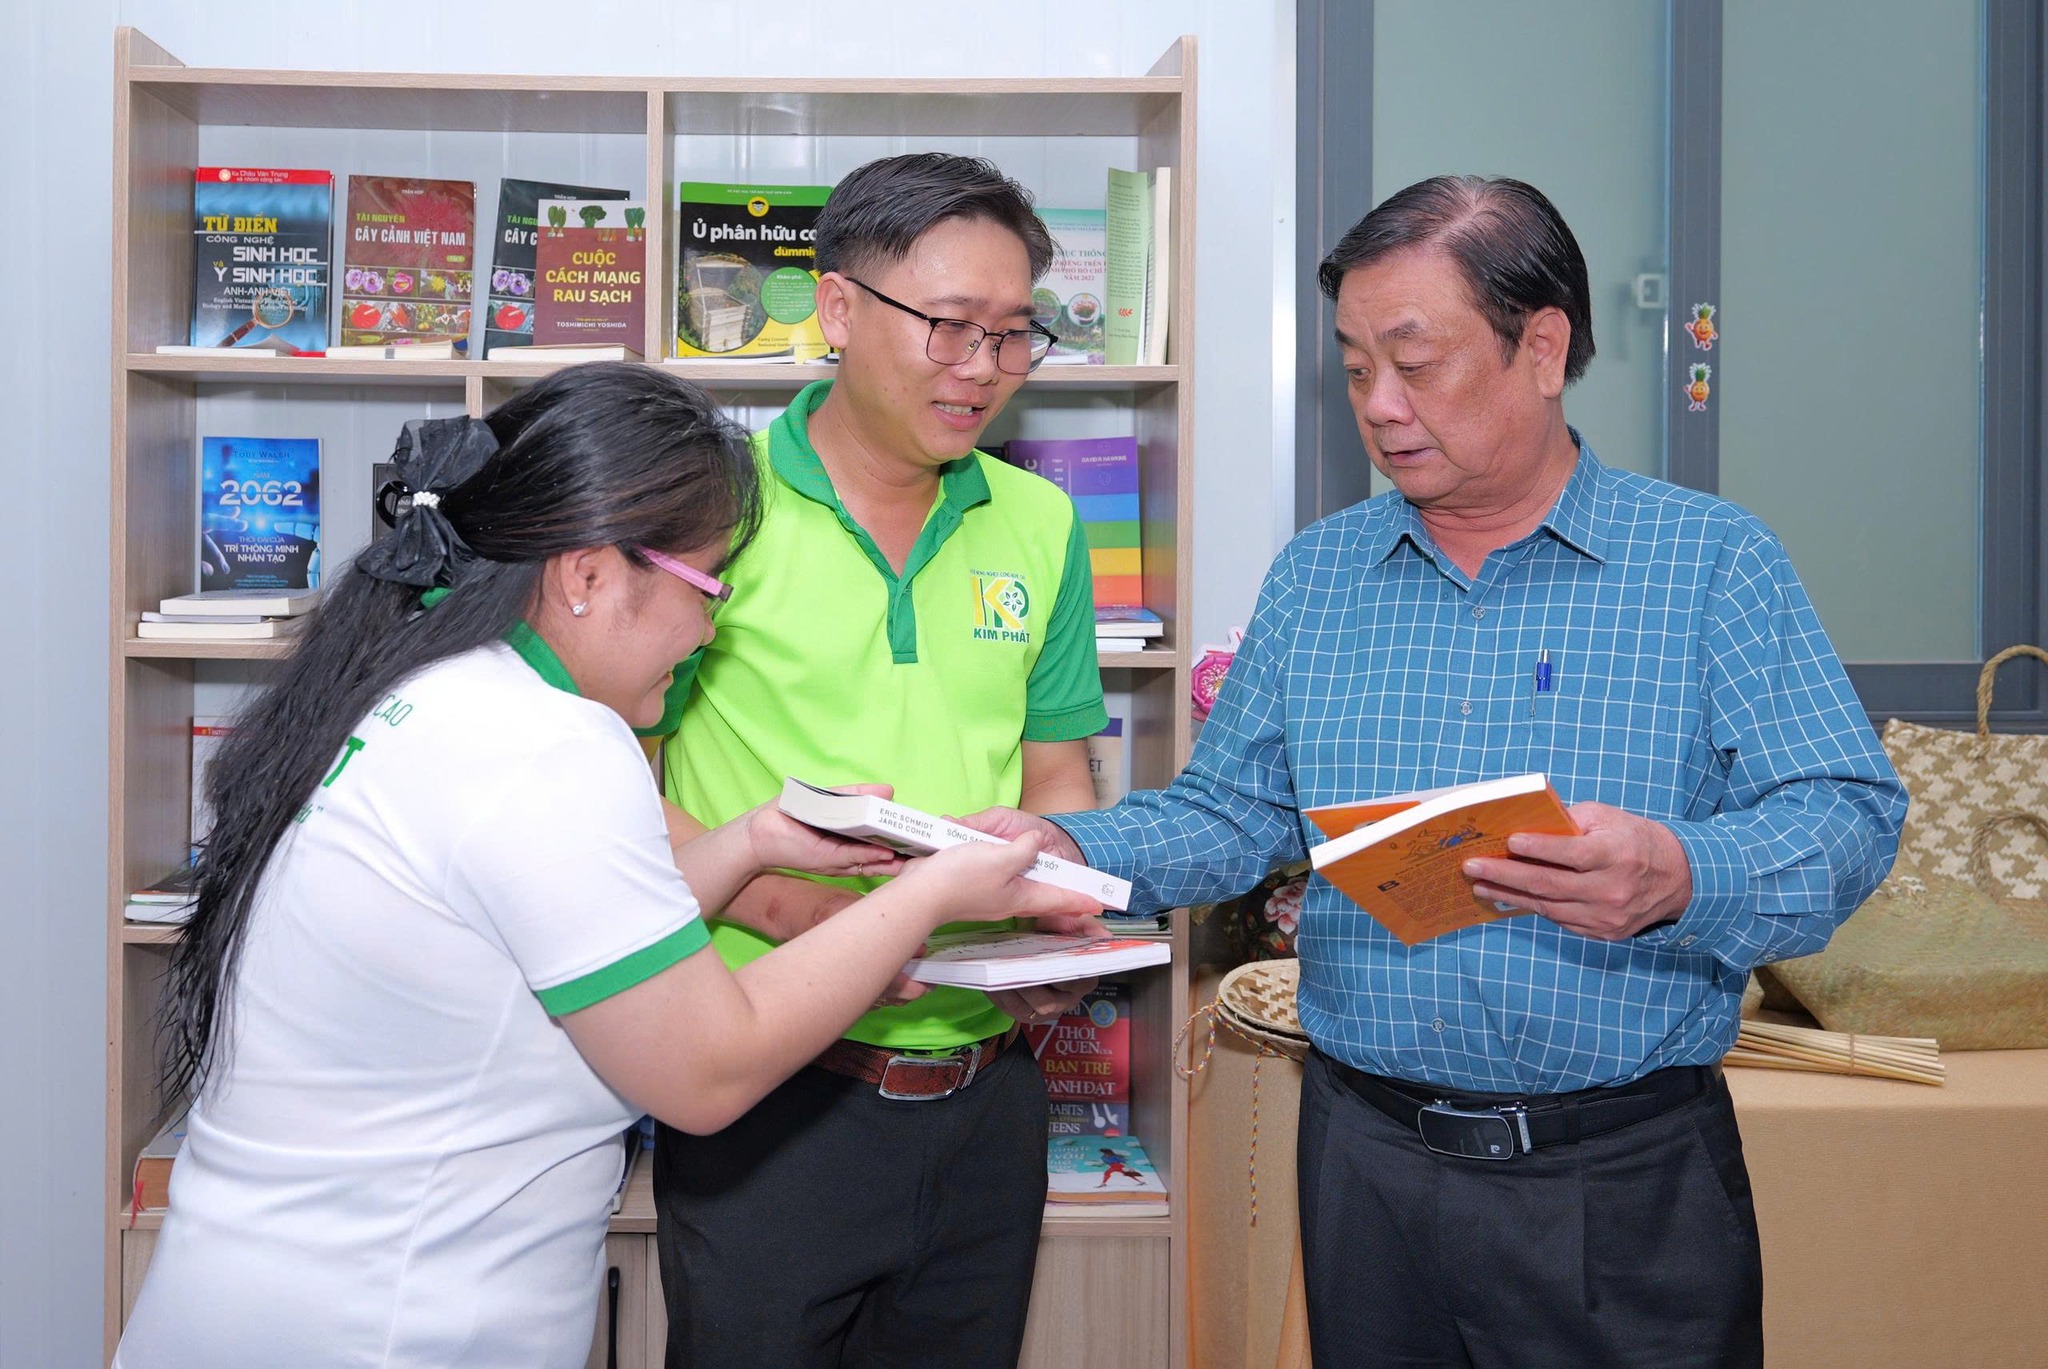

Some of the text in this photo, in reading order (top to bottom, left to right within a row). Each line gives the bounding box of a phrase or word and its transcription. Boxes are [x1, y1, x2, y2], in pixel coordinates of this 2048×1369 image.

[203, 211, 278, 233] TỪ ĐIỂN
[356, 212, 405, 223] TÀI NGUYÊN
[507, 214, 521, 225] TÀI
[355, 224, 466, 247] CÂY CẢNH VIỆT NAM
[504, 227, 528, 245] CÂY
[692, 217, 707, 238] Ủ
[710, 223, 757, 243] phân
[760, 224, 796, 241] hữu
[206, 235, 274, 245] CÔNG NGHỆ
[233, 246, 318, 266] SINH HỌC
[572, 248, 616, 268] CUỘC
[213, 267, 318, 286] Y SINH HỌC
[545, 267, 641, 287] CÁCH MẠNG
[553, 289, 632, 306] RAU SẠCH
[219, 479, 303, 506] 2062
[223, 543, 299, 553] TRÍ THÔNG MINH
[237, 552, 286, 564] NHÂN TẠO
[973, 628, 1030, 643] KIM PHÁT
[373, 694, 413, 726] CAO
[878, 817, 932, 839] JARED COHEN
[879, 808, 934, 830] ERIC SCHMIDT
[946, 828, 968, 841] SỐNG
[1056, 1024, 1096, 1040] THÓI
[1055, 1040, 1100, 1055] QUEN
[1046, 1058, 1112, 1075] BẠN TRẺ
[1047, 1076, 1116, 1097] ÀNH ĐẠT
